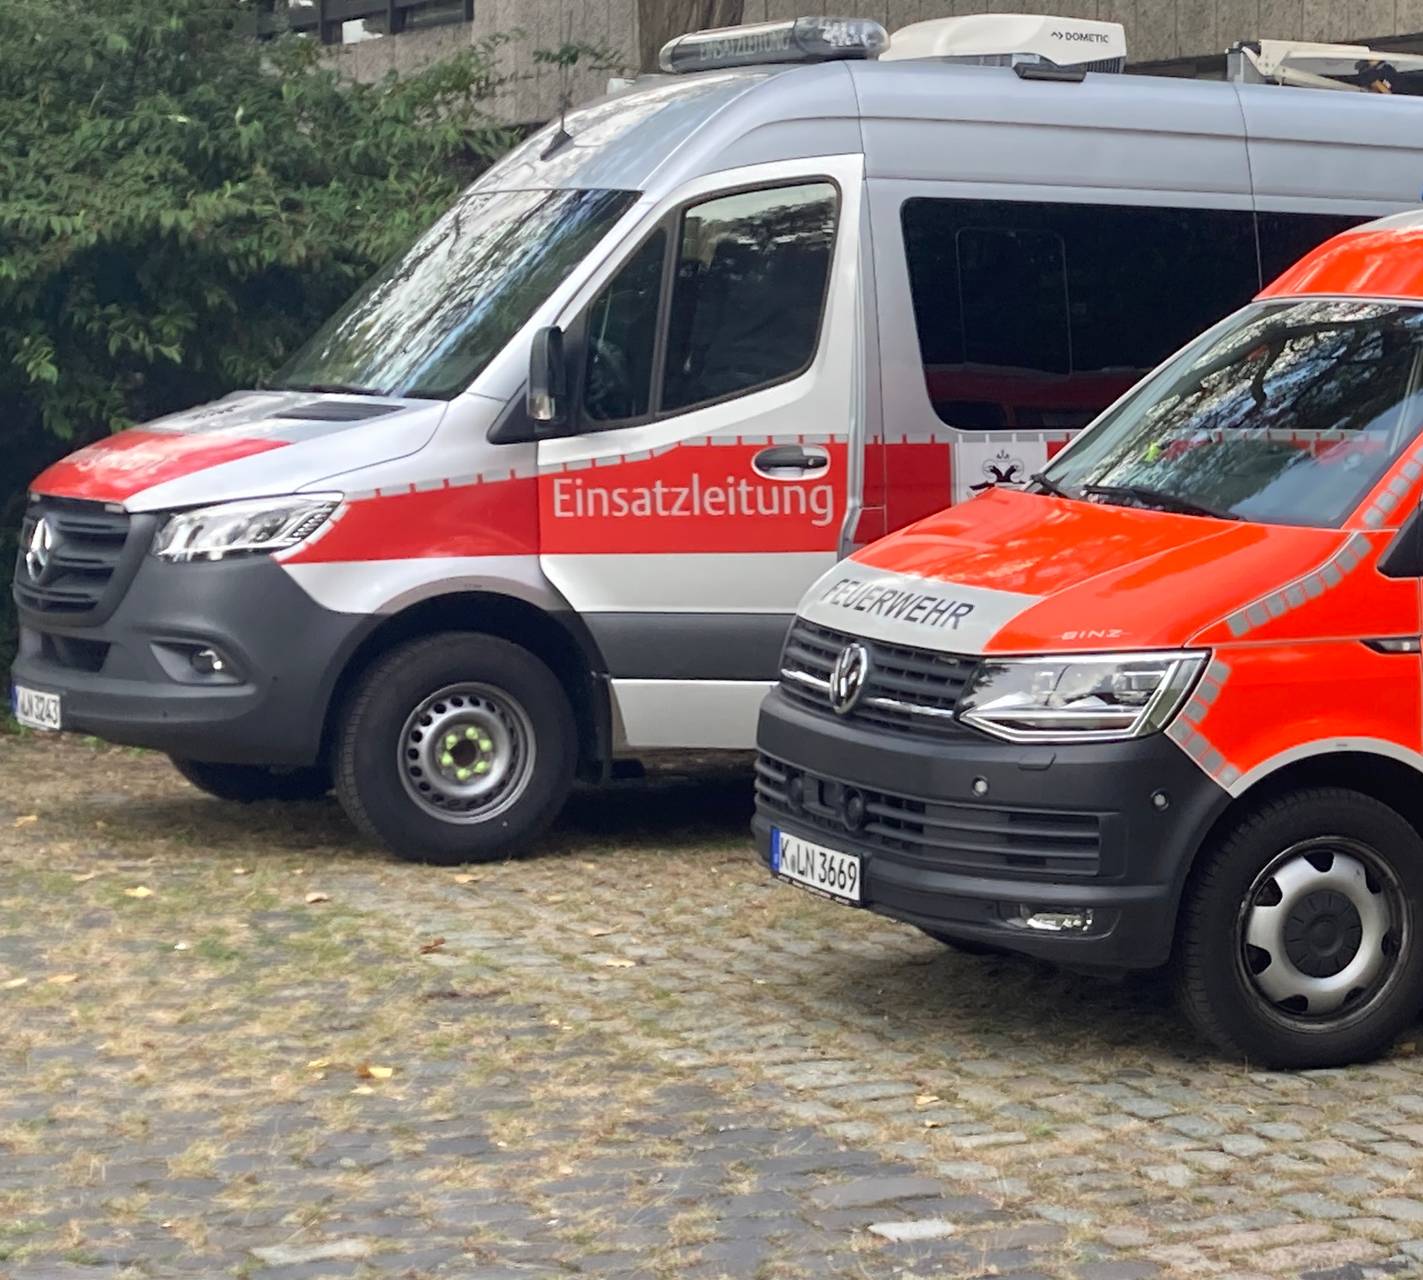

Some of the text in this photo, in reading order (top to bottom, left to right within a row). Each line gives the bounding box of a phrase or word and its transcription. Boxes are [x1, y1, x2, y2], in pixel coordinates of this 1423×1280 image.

[1065, 32, 1109, 43] DOMETIC
[553, 473, 834, 526] Einsatzleitung
[822, 578, 976, 630] FEUERWEHR
[818, 852, 857, 893] 3669
